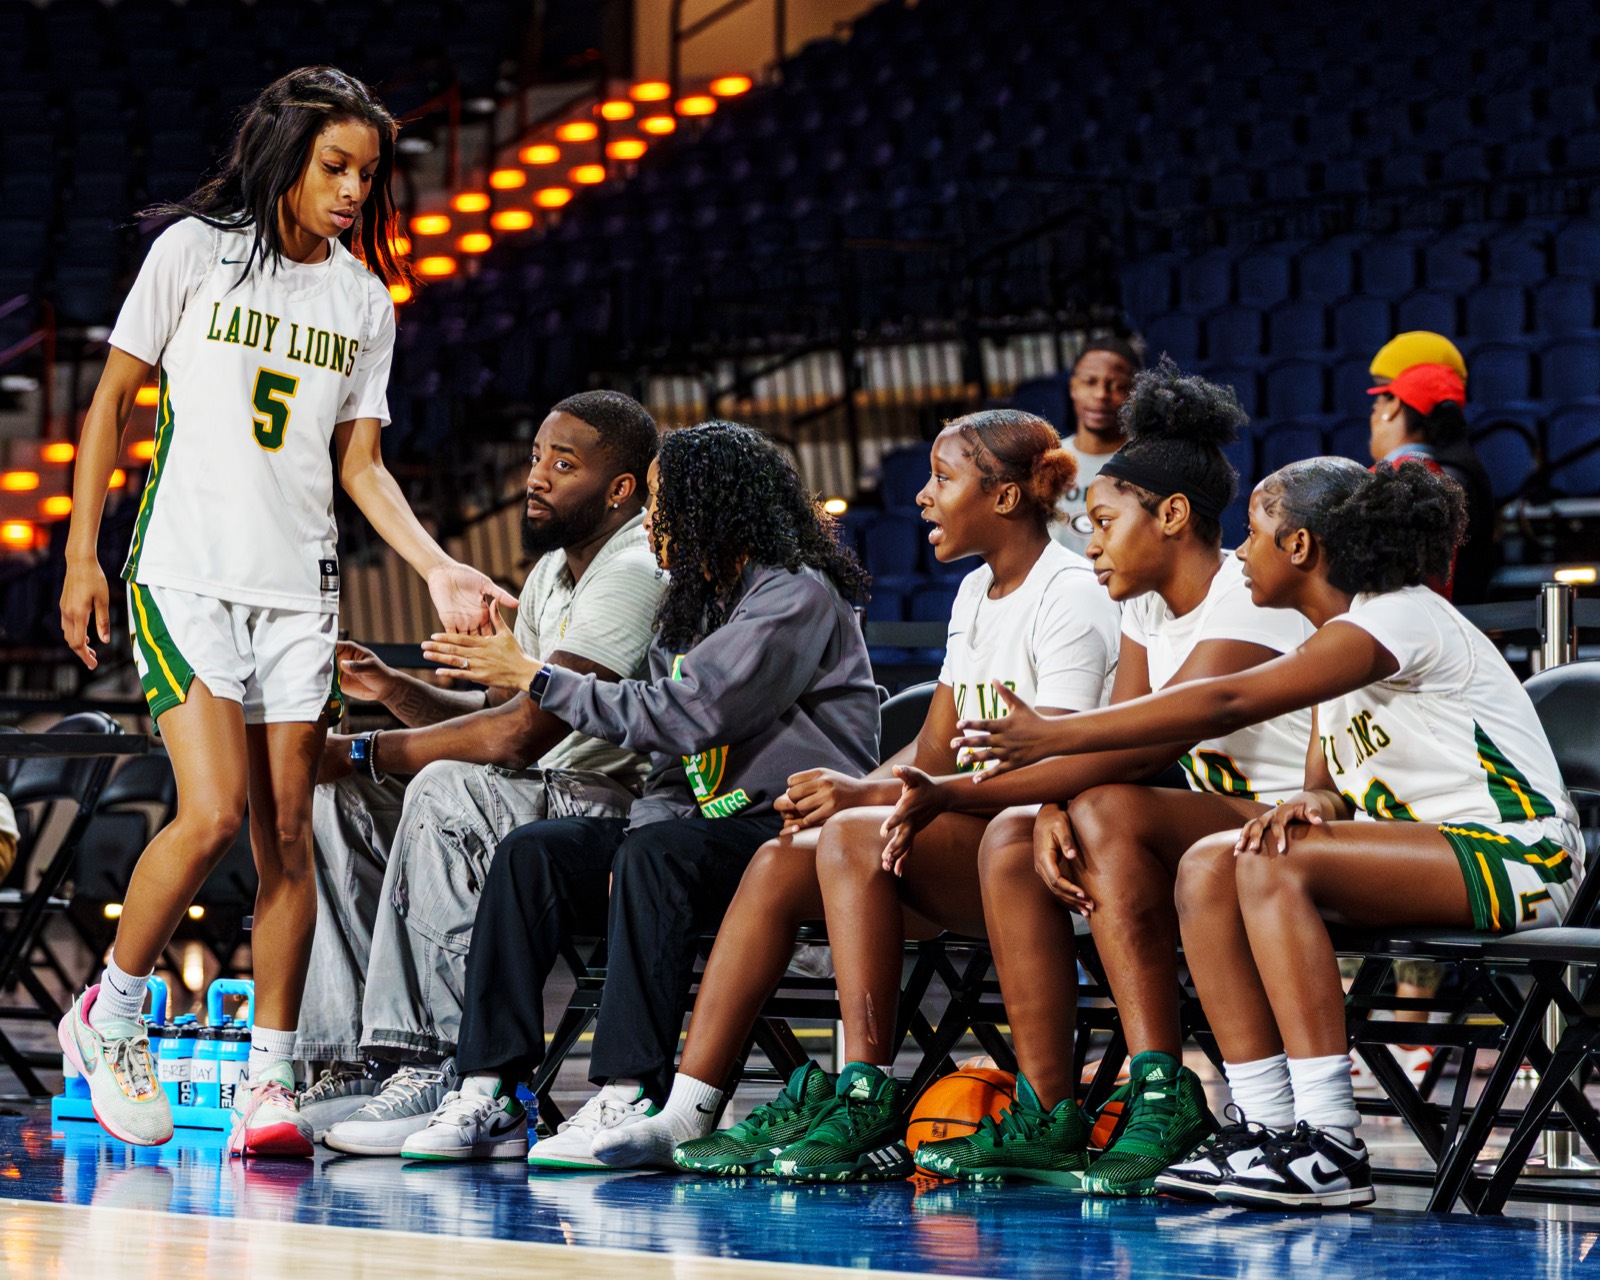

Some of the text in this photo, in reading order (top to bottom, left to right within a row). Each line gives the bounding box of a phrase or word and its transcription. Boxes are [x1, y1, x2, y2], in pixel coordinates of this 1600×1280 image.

[207, 302, 359, 378] LADY LIONS
[251, 366, 300, 453] 5
[325, 563, 333, 573] S
